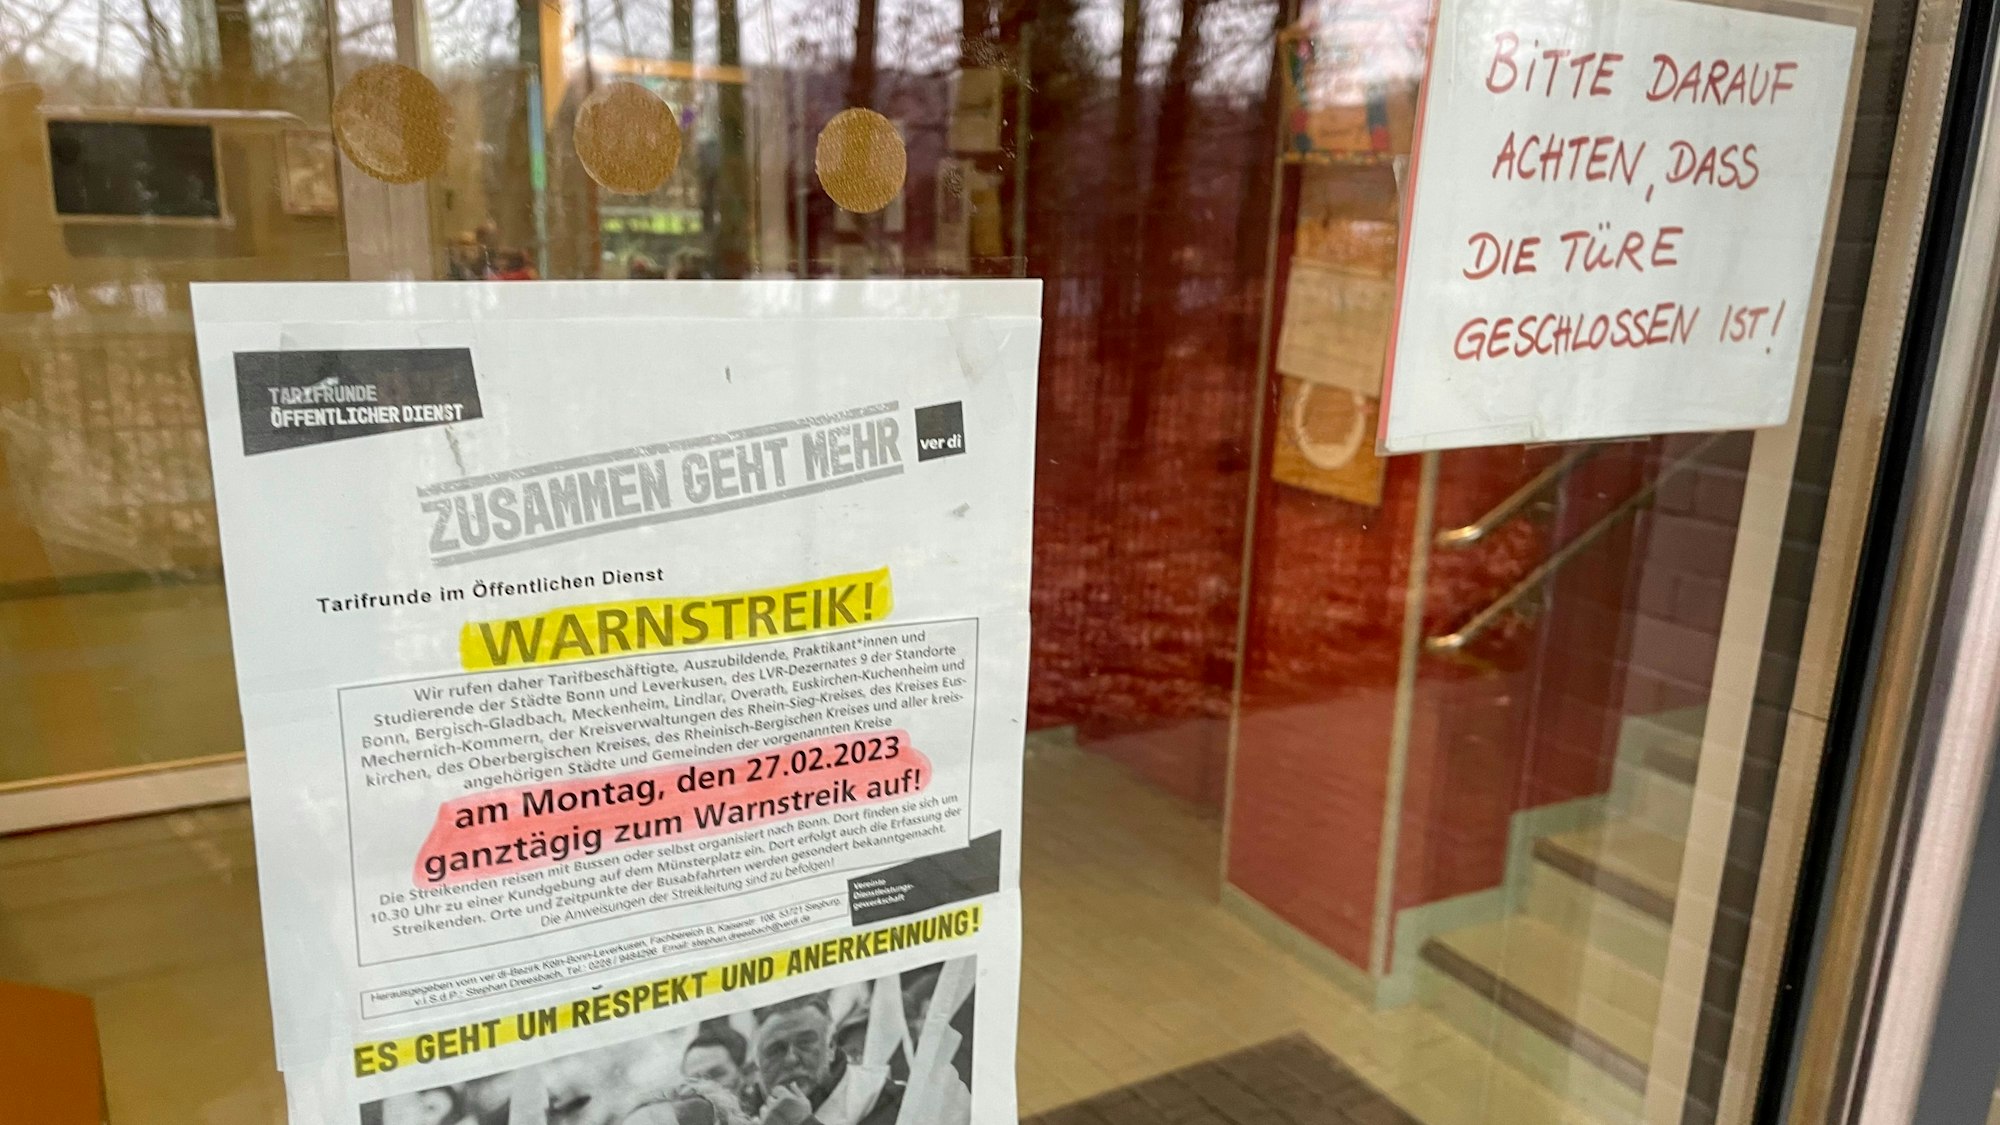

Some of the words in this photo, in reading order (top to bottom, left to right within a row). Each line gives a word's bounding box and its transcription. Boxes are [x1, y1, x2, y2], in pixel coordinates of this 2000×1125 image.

[1646, 54, 1798, 105] DARAUF
[1492, 131, 1654, 202] ACHTEN,
[1666, 140, 1759, 190] DASS
[1463, 232, 1541, 280] DIE
[1454, 302, 1700, 361] GESCHLOSSEN
[267, 384, 377, 406] TARIFRUNDE
[269, 403, 400, 429] ÖFFENTLICHER
[402, 402, 464, 423] DIENST
[421, 457, 674, 554] ZUSAMMEN
[681, 437, 788, 504] GEHT
[801, 416, 902, 482] MEHR
[317, 587, 432, 615] Tarifrunde
[439, 585, 464, 602] im
[473, 575, 595, 601] Öffentlichen
[602, 567, 664, 585] Dienst
[479, 582, 875, 666] WARNSTREIK!
[455, 801, 508, 830] am
[522, 779, 664, 817] Montag,
[677, 767, 735, 793] den
[746, 736, 899, 783] 27.02.2023
[424, 826, 601, 882] ganztägig
[614, 814, 682, 844] zum
[693, 780, 857, 830] Warnstreik
[866, 769, 921, 799] auf!
[354, 1043, 398, 1078] ES
[415, 1018, 501, 1064] GEHT
[517, 1007, 558, 1041] UM
[571, 971, 708, 1028] RESPEKT
[721, 956, 774, 992] UND
[787, 907, 980, 974] ANERKENNUNG!
